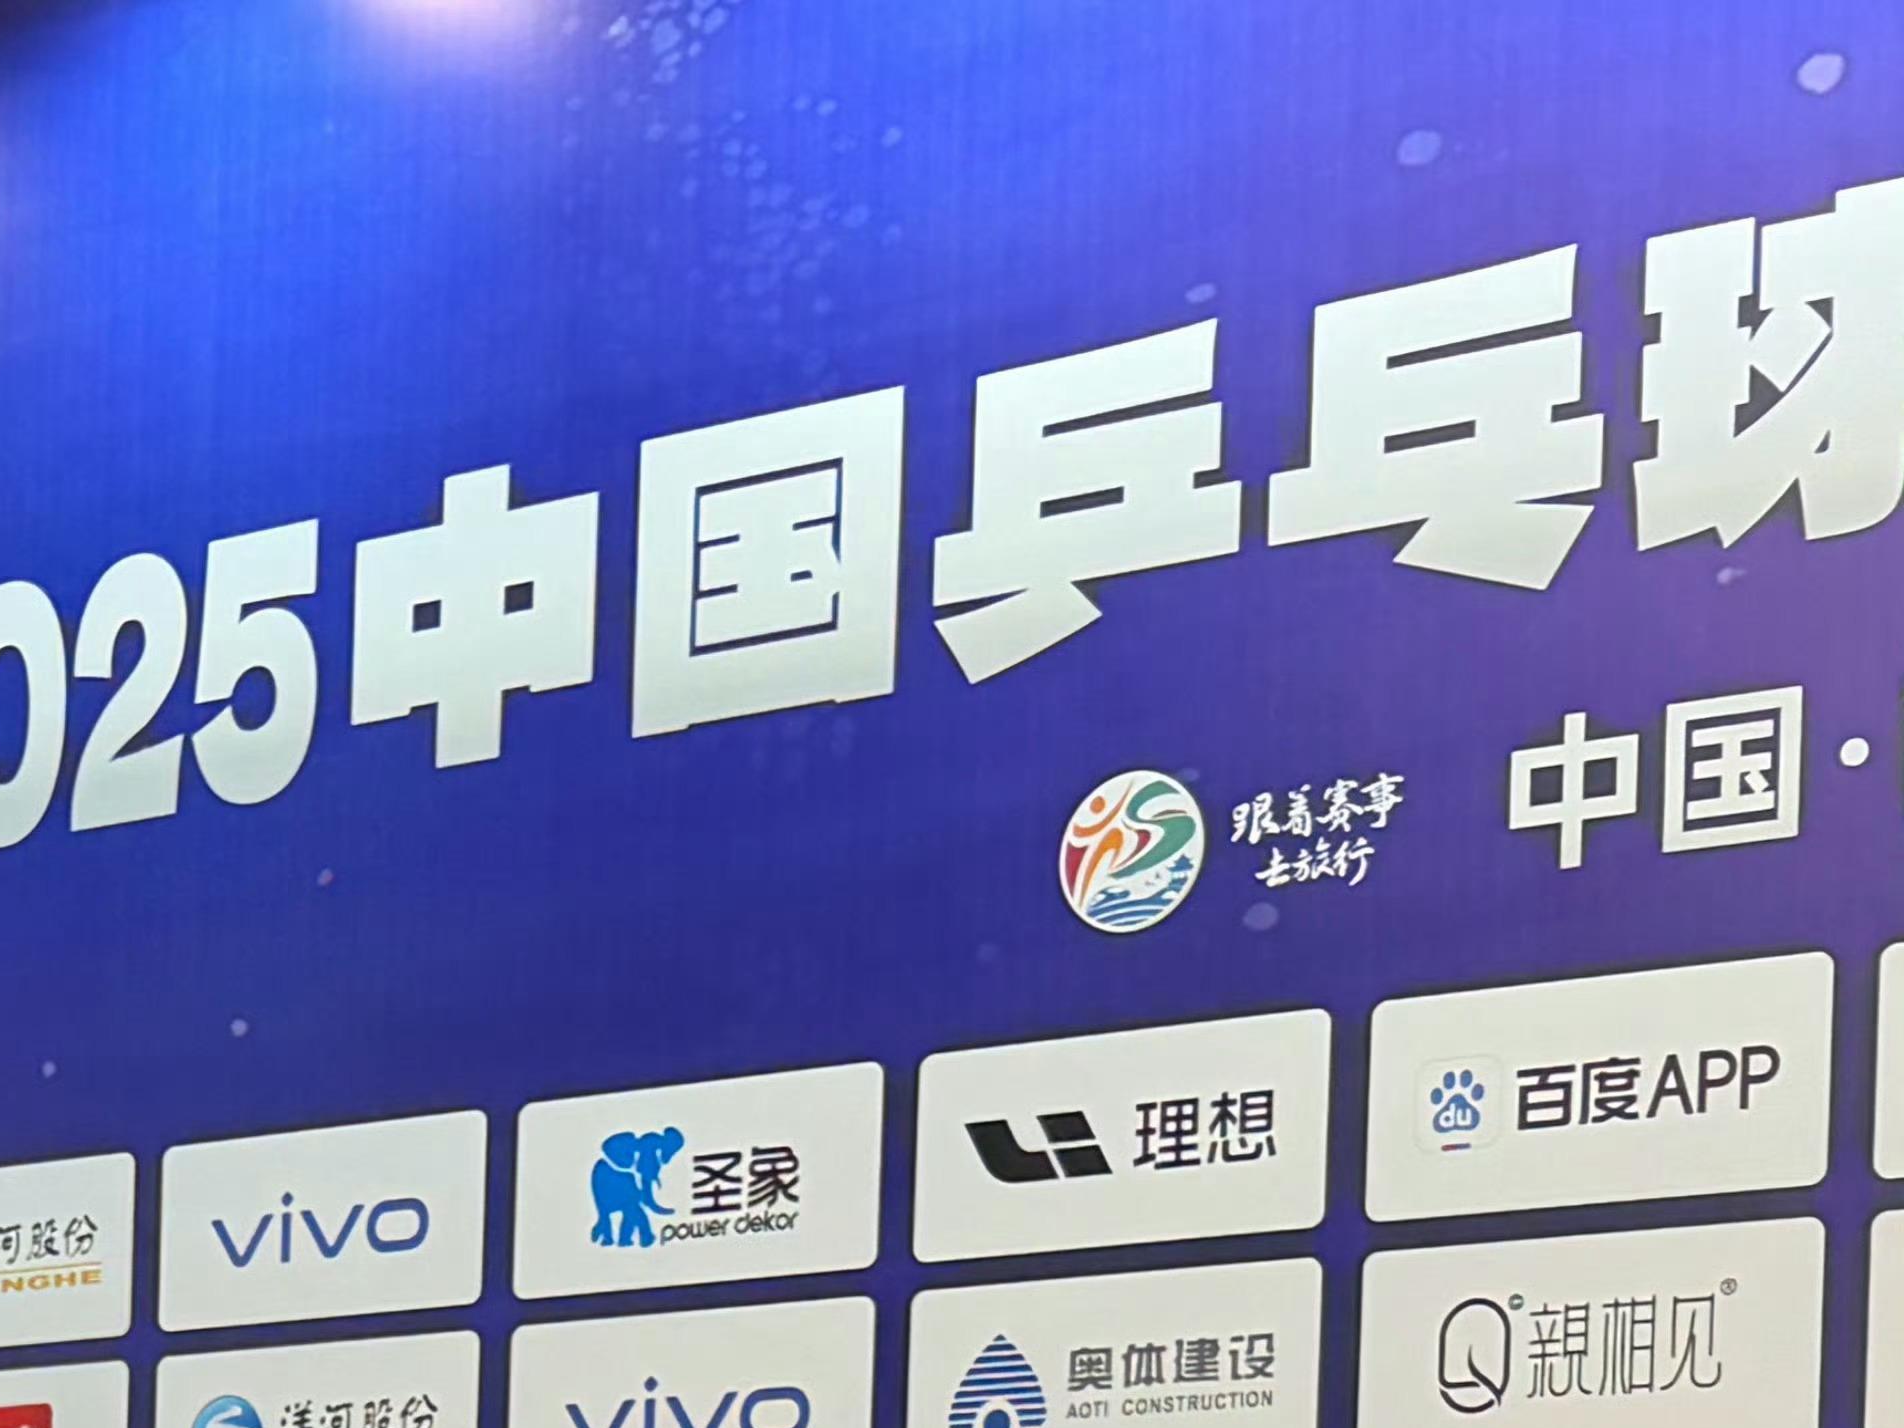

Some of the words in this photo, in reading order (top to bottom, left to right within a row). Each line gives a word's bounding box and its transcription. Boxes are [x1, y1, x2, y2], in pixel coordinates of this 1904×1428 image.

[1230, 773, 1405, 845] 跟着赛事
[1254, 835, 1376, 888] 去旅行
[1515, 1044, 1781, 1132] 百度APP
[1132, 1088, 1278, 1171] 理想
[690, 1145, 801, 1216] 圣象
[210, 1191, 431, 1269] vivo
[659, 1215, 731, 1247] power
[734, 1209, 799, 1236] dekor
[1066, 1332, 1276, 1393] 奥体建设
[1065, 1398, 1109, 1421] AOTI
[1121, 1389, 1274, 1419] CONSTRUCTION
